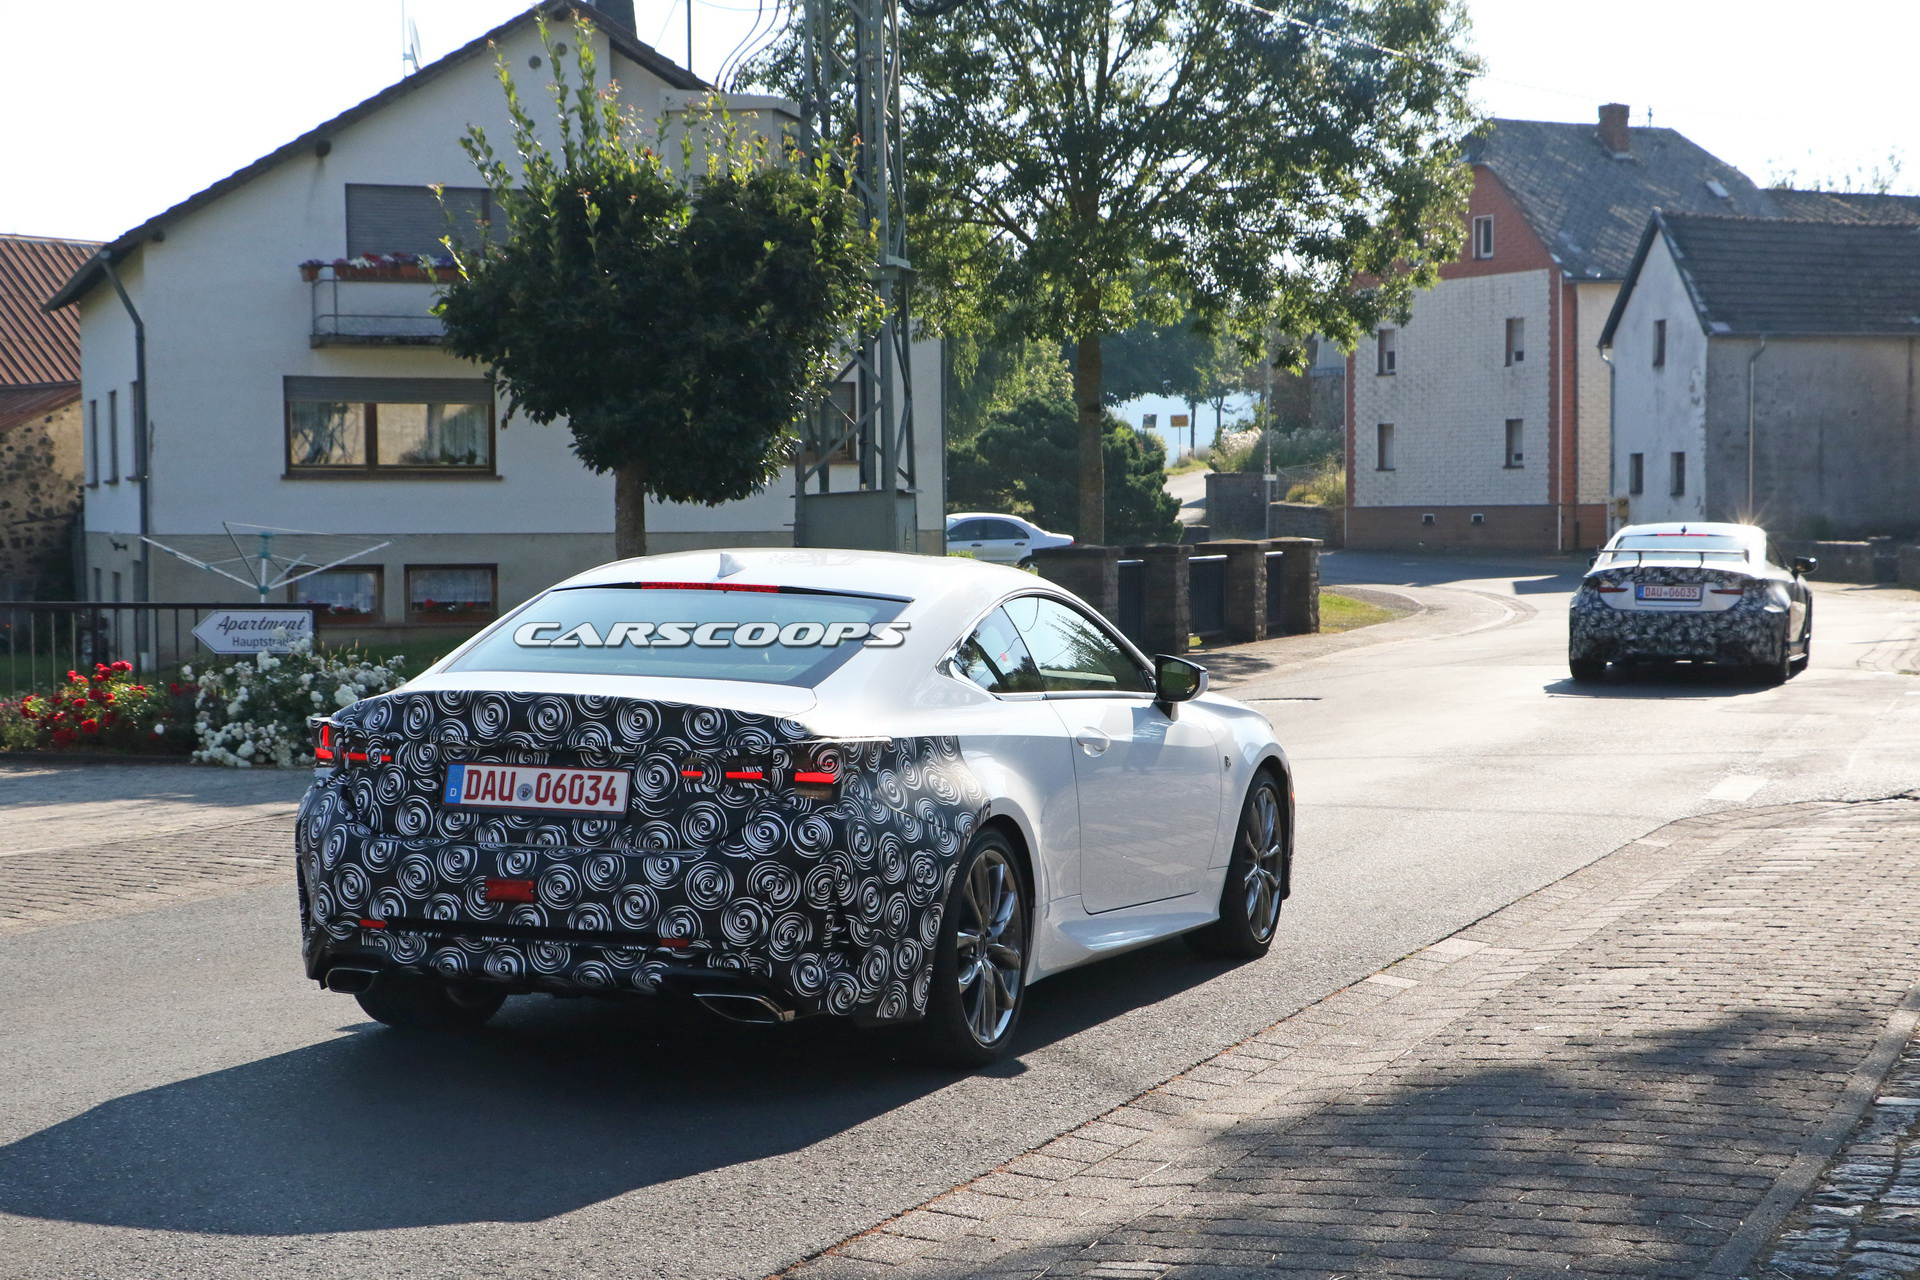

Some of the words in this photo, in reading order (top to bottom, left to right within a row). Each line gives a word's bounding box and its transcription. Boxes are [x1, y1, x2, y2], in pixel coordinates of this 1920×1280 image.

[1645, 587, 1663, 597] DAU
[1669, 587, 1697, 598] 06035
[216, 616, 306, 636] Apartment
[449, 787, 457, 797] D
[464, 769, 516, 802] DAU
[535, 772, 619, 807] 06034
